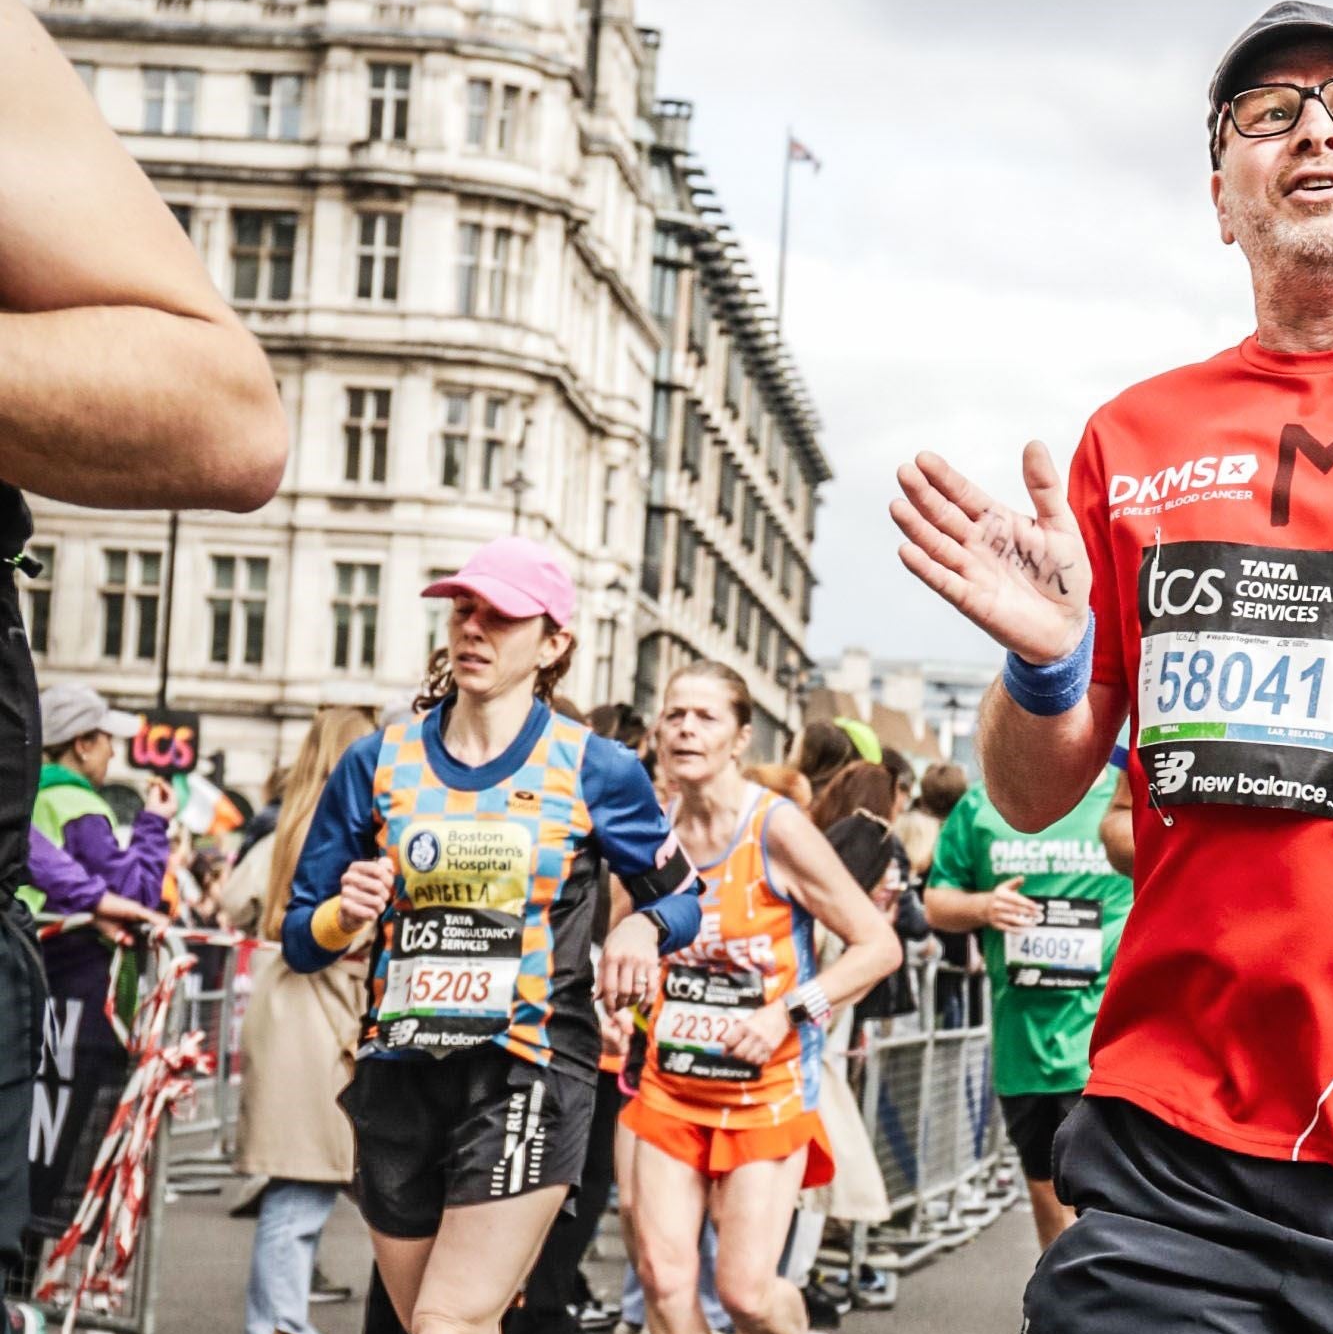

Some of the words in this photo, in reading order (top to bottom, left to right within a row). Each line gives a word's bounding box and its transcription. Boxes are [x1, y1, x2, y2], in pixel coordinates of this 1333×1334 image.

[1108, 456, 1219, 507] DKMS
[1122, 499, 1163, 516] DELETE
[1165, 493, 1200, 511] BLOOD
[1201, 490, 1253, 501] CANCER
[1240, 559, 1299, 580] TATA
[1148, 560, 1226, 618] tcs
[1231, 600, 1319, 623] SERVICES
[1157, 650, 1326, 719] 58041
[1192, 775, 1234, 793] new
[1237, 773, 1327, 803] balance
[448, 830, 503, 842] Boston
[446, 844, 524, 858] Children's
[990, 840, 1107, 861] MACMILLA
[447, 859, 512, 874] Hospital
[414, 882, 490, 903] ANGELA
[444, 914, 473, 926] TATA
[401, 918, 439, 953] tcs
[442, 927, 516, 940] CONSULTANCY
[440, 939, 489, 952] SERVICES
[1020, 936, 1084, 961] 46097
[404, 971, 492, 1004] 15203
[414, 1032, 440, 1044] new
[671, 1013, 744, 1043] 2232
[506, 1092, 526, 1132] RUN
